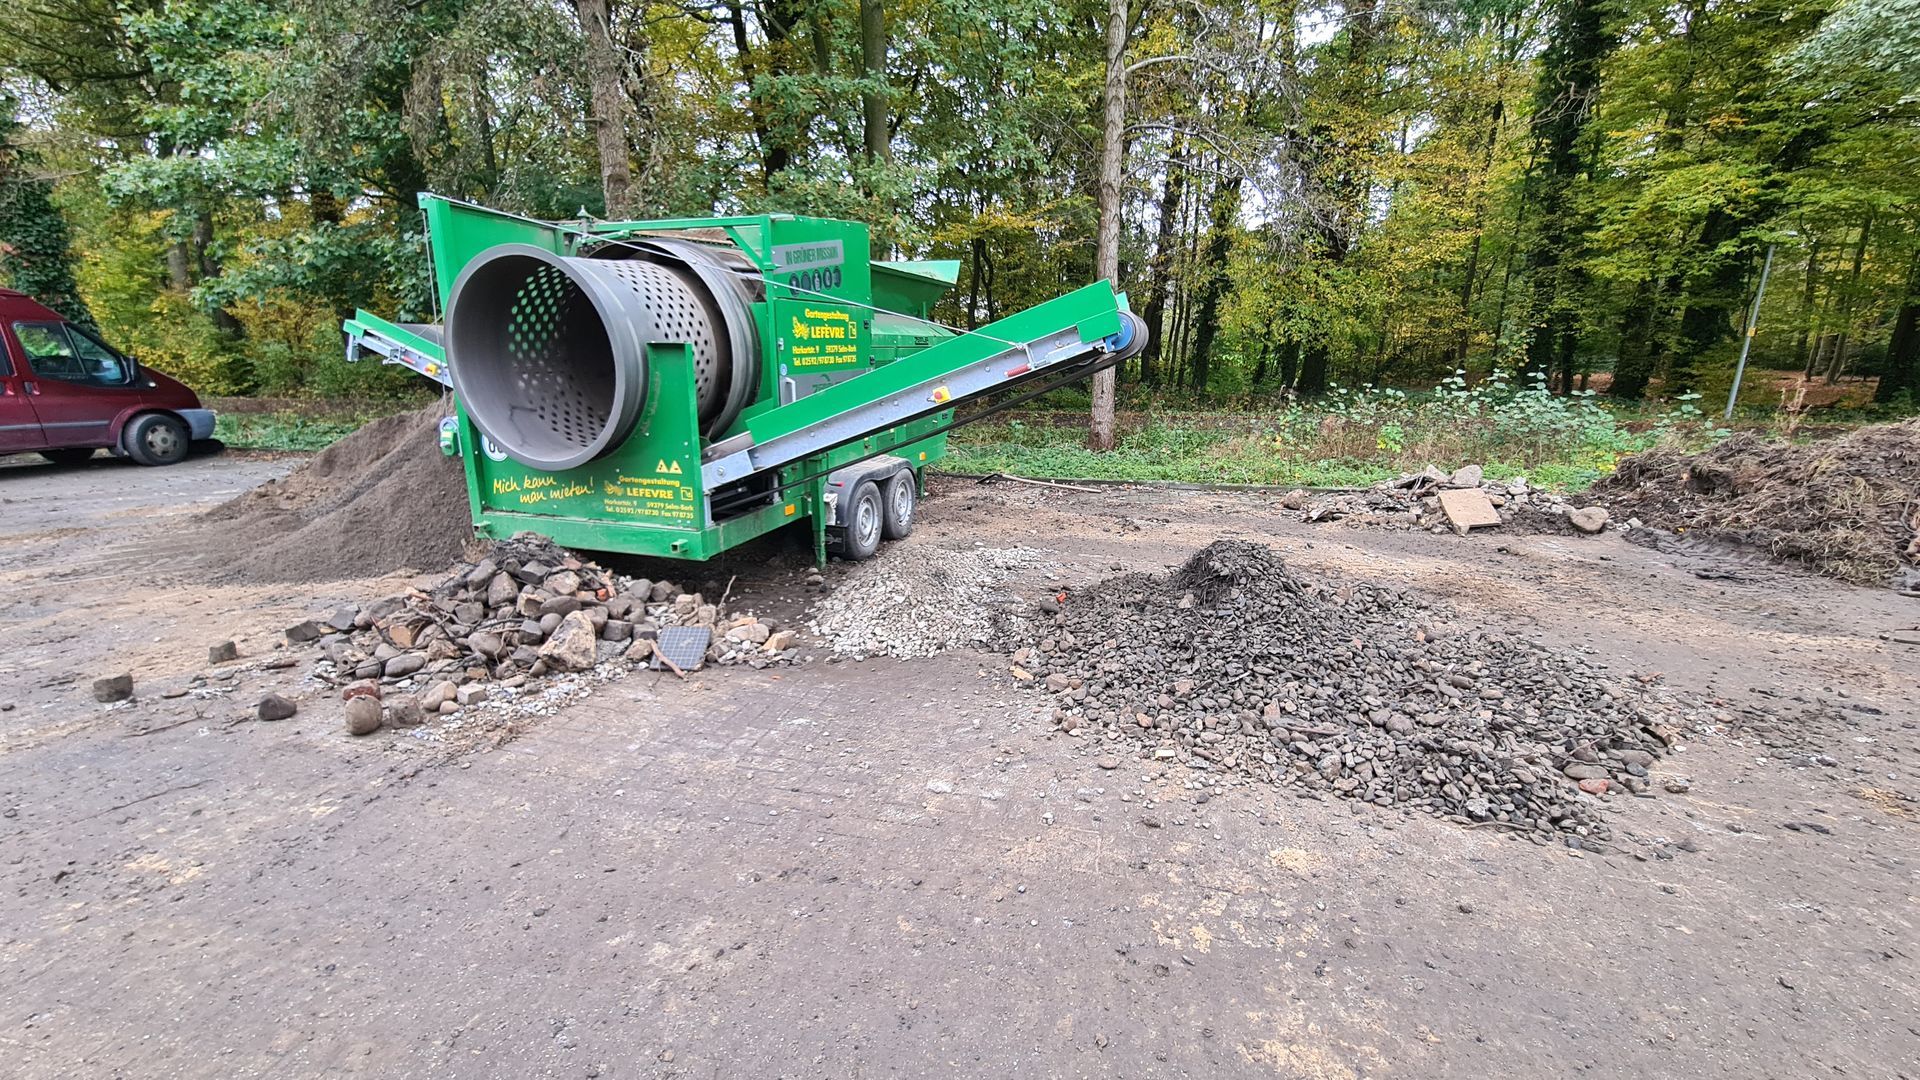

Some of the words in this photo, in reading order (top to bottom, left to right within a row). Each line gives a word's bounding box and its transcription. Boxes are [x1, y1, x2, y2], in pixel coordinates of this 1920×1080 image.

[493, 476, 521, 494] Mich
[523, 475, 557, 489] kann
[519, 491, 547, 504] man
[550, 476, 595, 500] mieten!
[618, 475, 681, 488] Gartengestaltung
